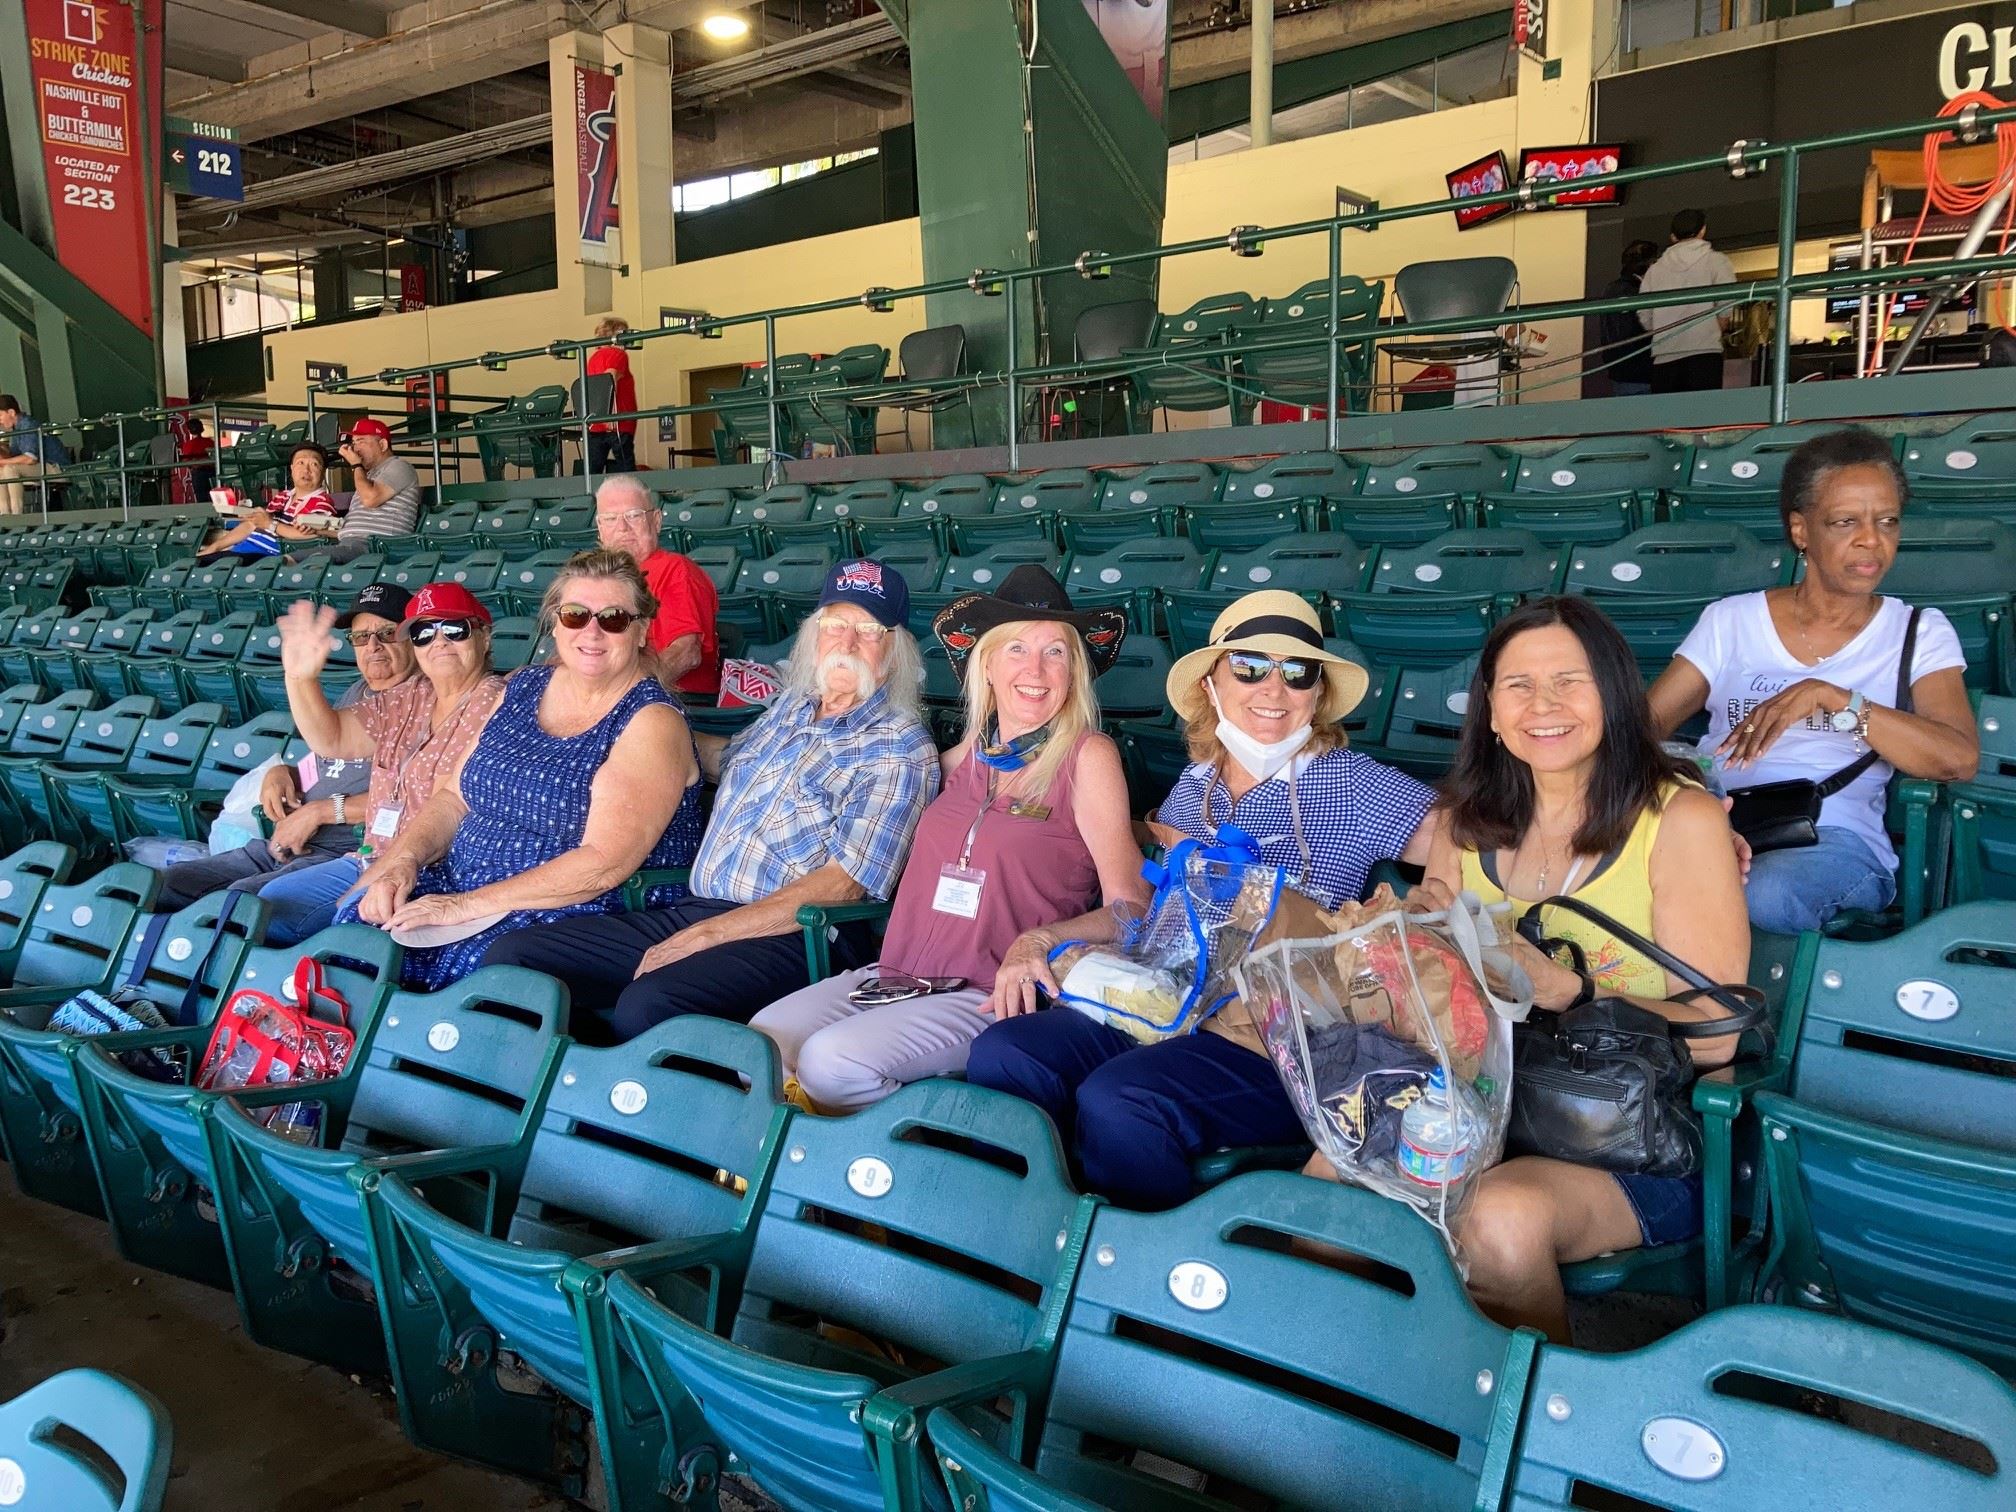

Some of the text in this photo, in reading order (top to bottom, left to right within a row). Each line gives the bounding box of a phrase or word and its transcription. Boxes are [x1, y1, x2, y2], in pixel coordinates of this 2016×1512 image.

[31, 37, 131, 75] STRIKE ZONE
[72, 62, 132, 88] Chicken
[45, 83, 121, 110] NASHVILLE HOT
[81, 105, 89, 118] &
[47, 114, 123, 141] BUTTERMILK
[193, 122, 232, 140] SECTION
[48, 129, 125, 151] CHICKEN SANDWICHES
[55, 155, 121, 174] LOCATED AT
[198, 149, 232, 175] 212
[64, 167, 112, 183] SECTION
[63, 184, 116, 210] 223
[836, 575, 886, 599] USA
[1921, 989, 1935, 1011] 7
[621, 1088, 638, 1108] 10
[863, 1167, 877, 1188] 9
[1190, 1274, 1206, 1298] 8
[1673, 1433, 1694, 1463] 7
